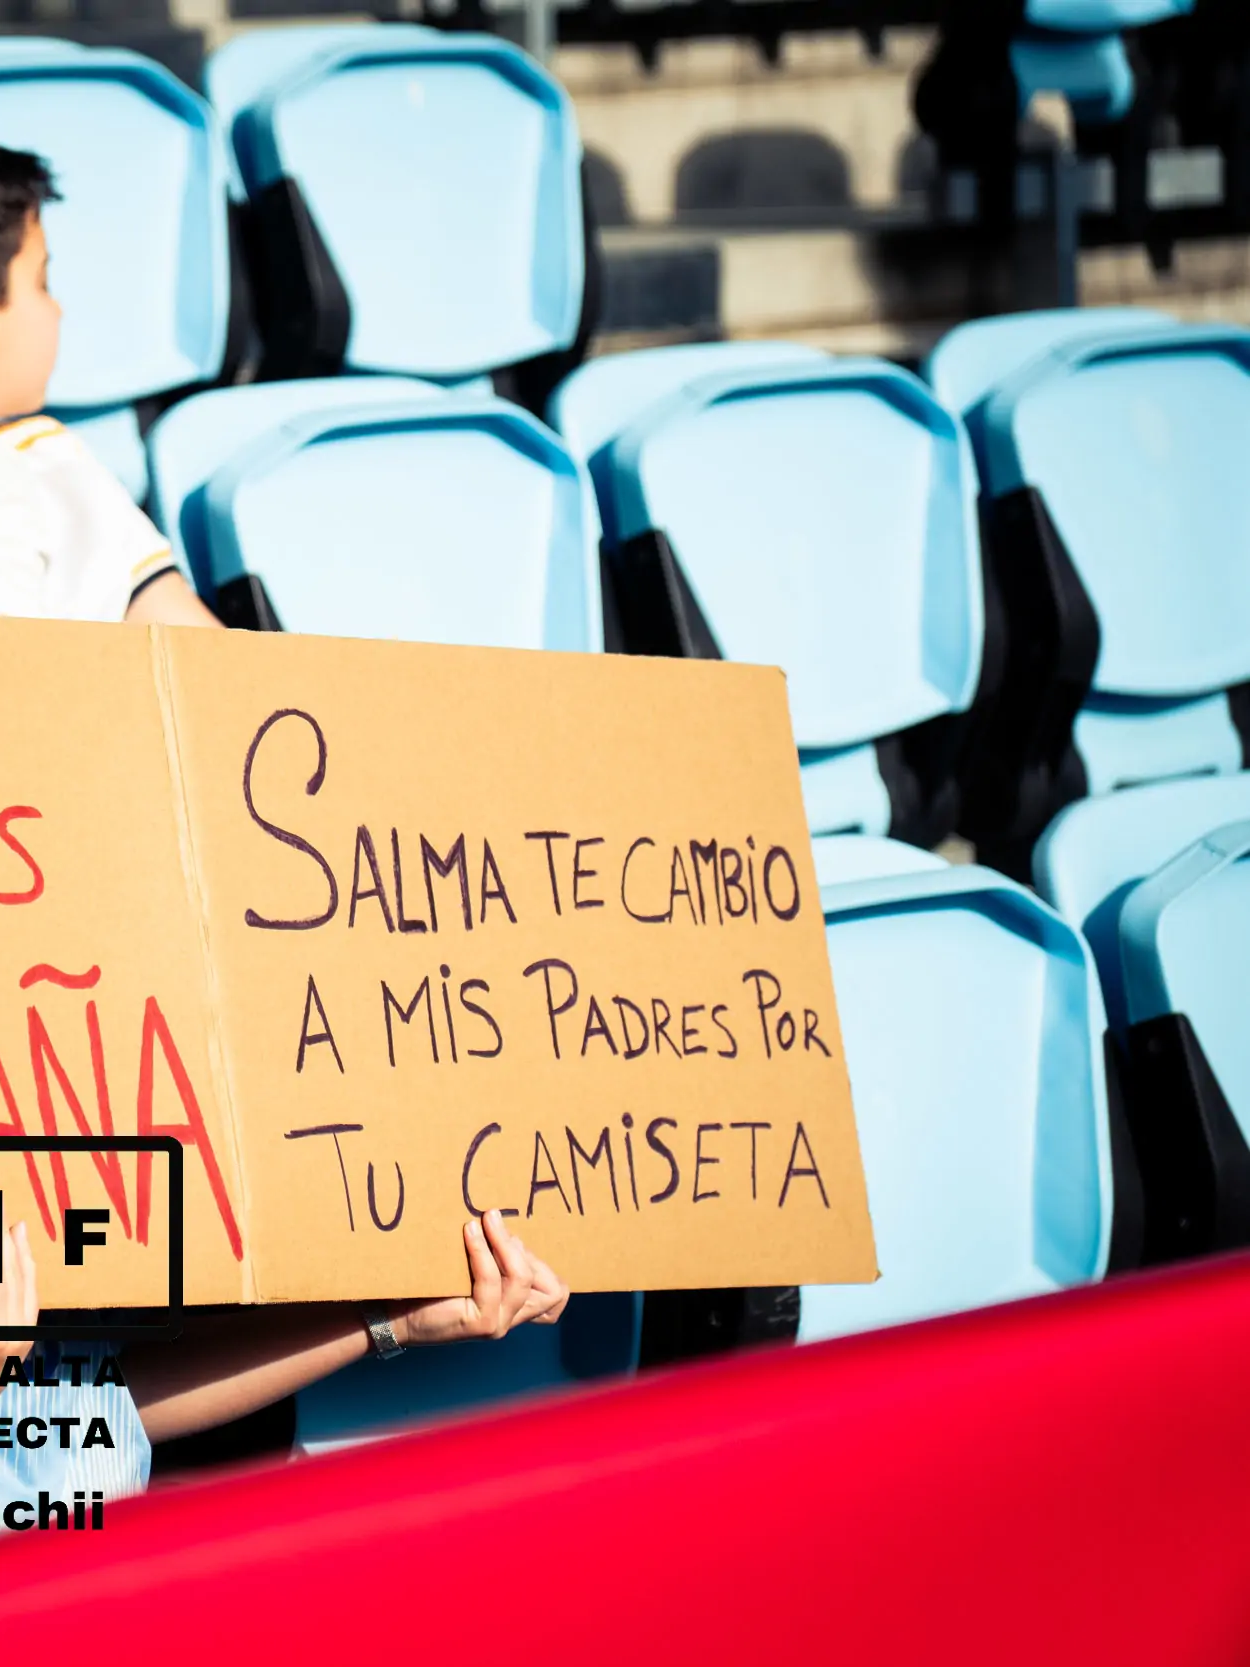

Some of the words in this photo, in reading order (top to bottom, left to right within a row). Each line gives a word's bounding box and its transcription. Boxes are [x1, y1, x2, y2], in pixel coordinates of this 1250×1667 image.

[243, 708, 518, 934] SALMA
[524, 830, 606, 916] TE
[296, 974, 345, 1074] A
[522, 958, 738, 1061] PADRES
